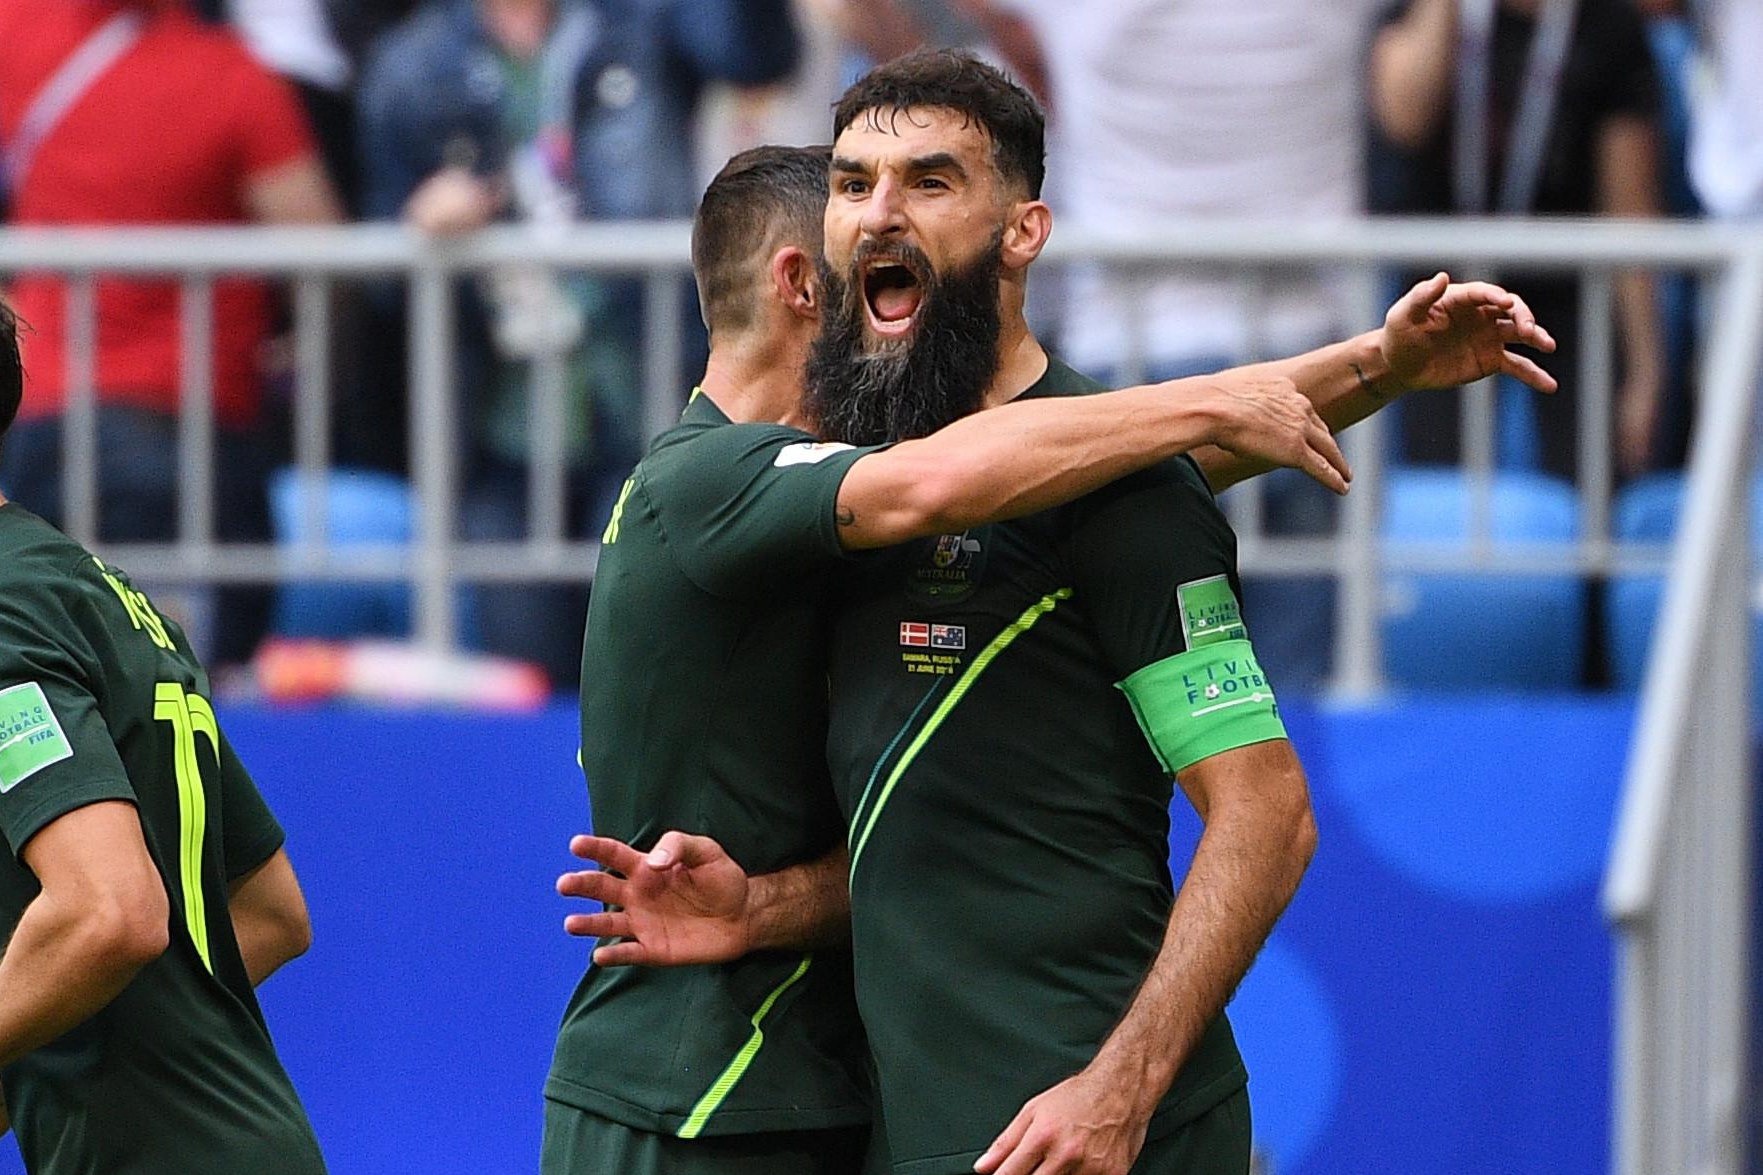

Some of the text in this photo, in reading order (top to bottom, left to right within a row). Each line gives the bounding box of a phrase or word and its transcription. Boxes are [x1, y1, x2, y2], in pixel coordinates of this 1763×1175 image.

[1183, 658, 1255, 688] LIVI
[1188, 674, 1269, 704] FOOTB
[28, 729, 55, 745] FIFA
